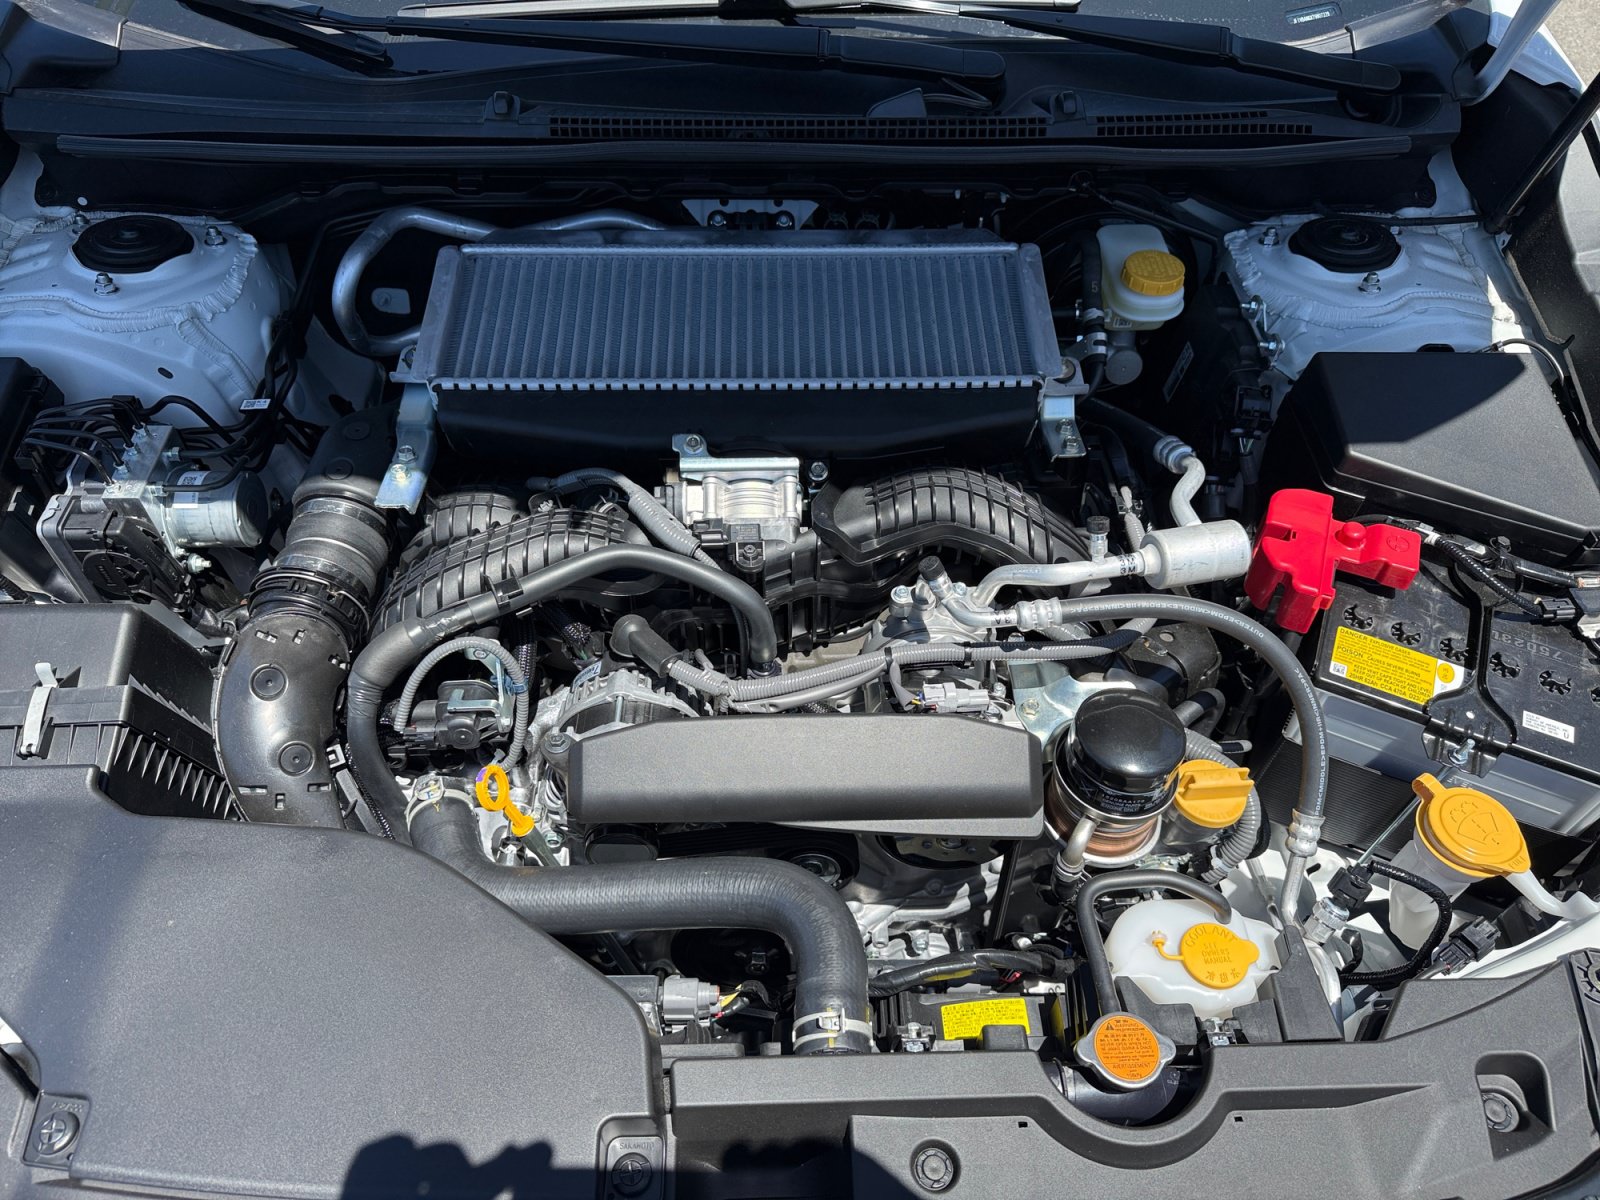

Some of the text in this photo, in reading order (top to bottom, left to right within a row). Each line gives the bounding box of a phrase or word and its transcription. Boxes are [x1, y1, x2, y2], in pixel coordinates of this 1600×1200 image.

[1339, 628, 1368, 641] DANGER
[1369, 639, 1395, 650] EXPLOSIVE
[1336, 645, 1364, 658] POISON
[1366, 656, 1385, 665] CAUSES
[1405, 668, 1421, 678] BURNS
[1185, 925, 1238, 948] COOLANT
